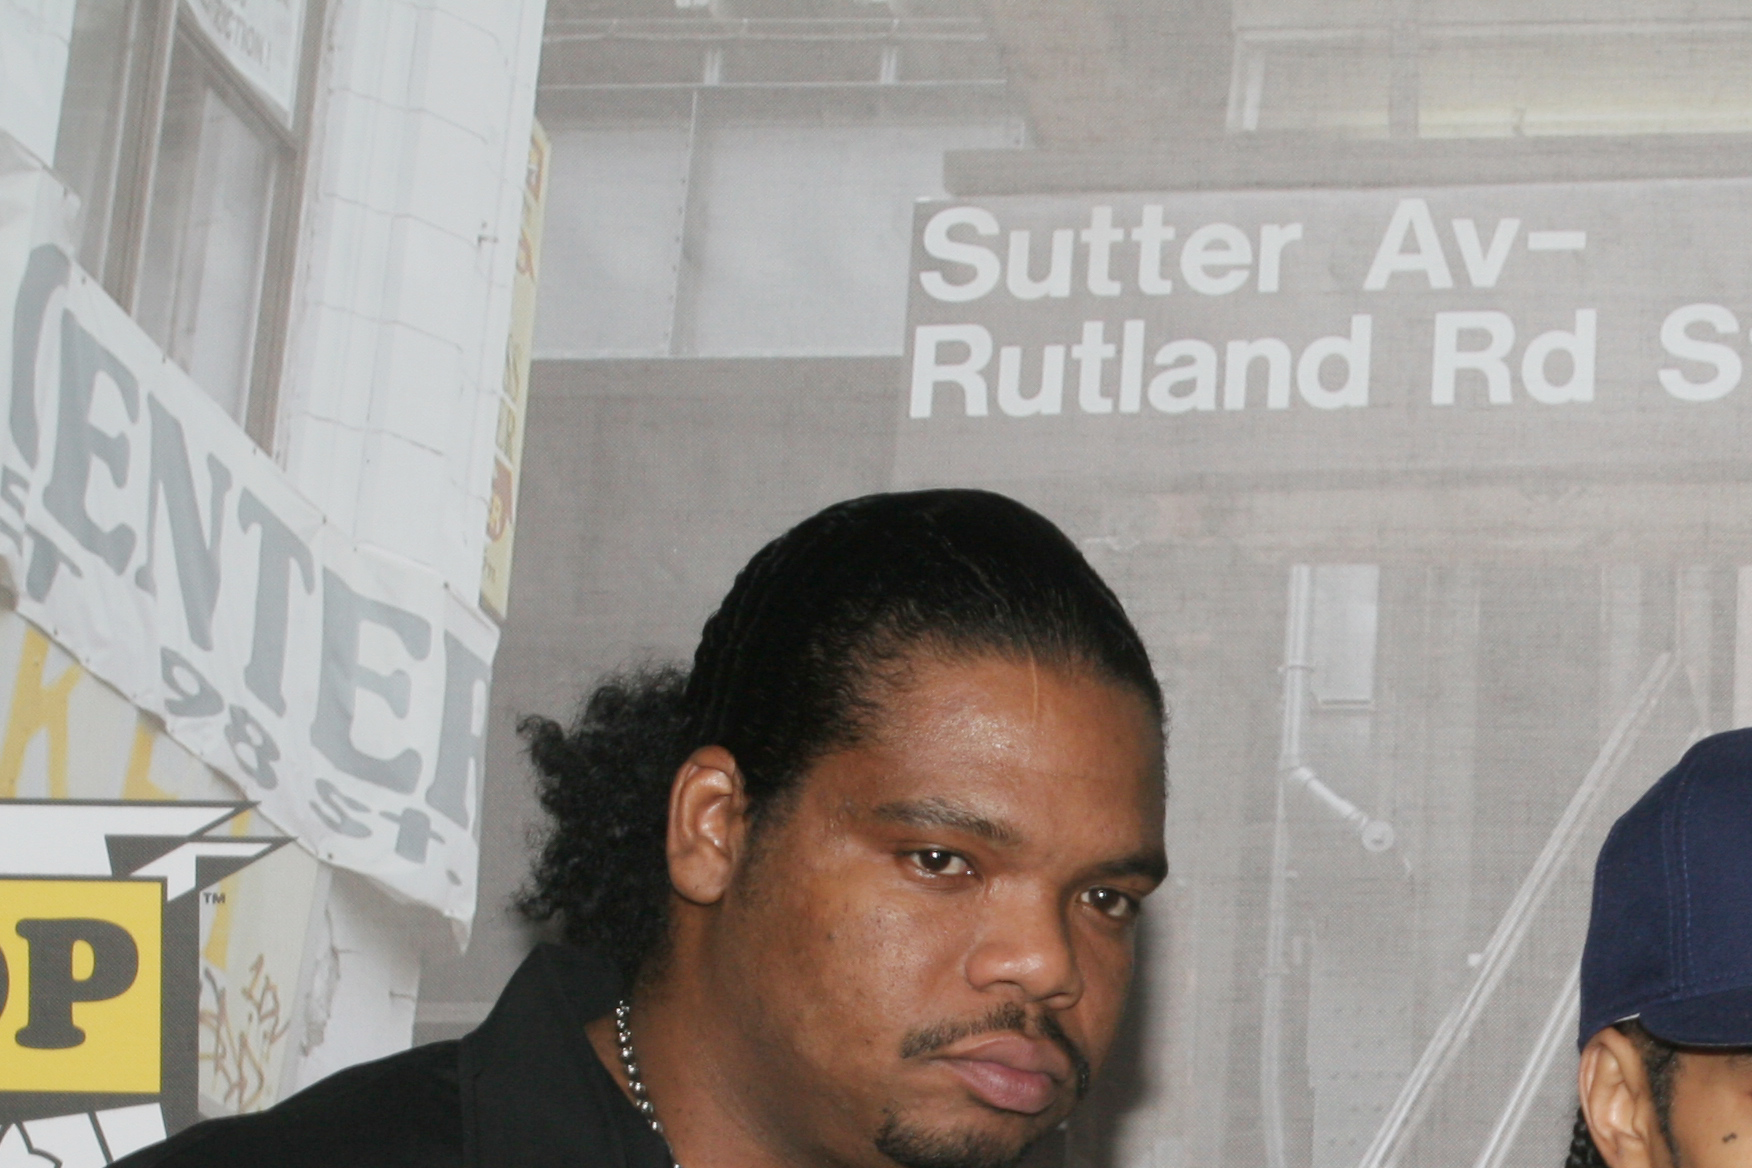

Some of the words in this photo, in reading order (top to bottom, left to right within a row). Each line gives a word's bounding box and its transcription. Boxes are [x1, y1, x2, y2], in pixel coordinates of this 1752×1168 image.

[920, 204, 1303, 302] Sutter
[1363, 198, 1586, 291] Av-
[910, 314, 1373, 418] Rutland
[1432, 308, 1596, 405] Rd
[160, 647, 280, 790] 98
[203, 892, 226, 904] TM
[0, 918, 140, 1050] P
